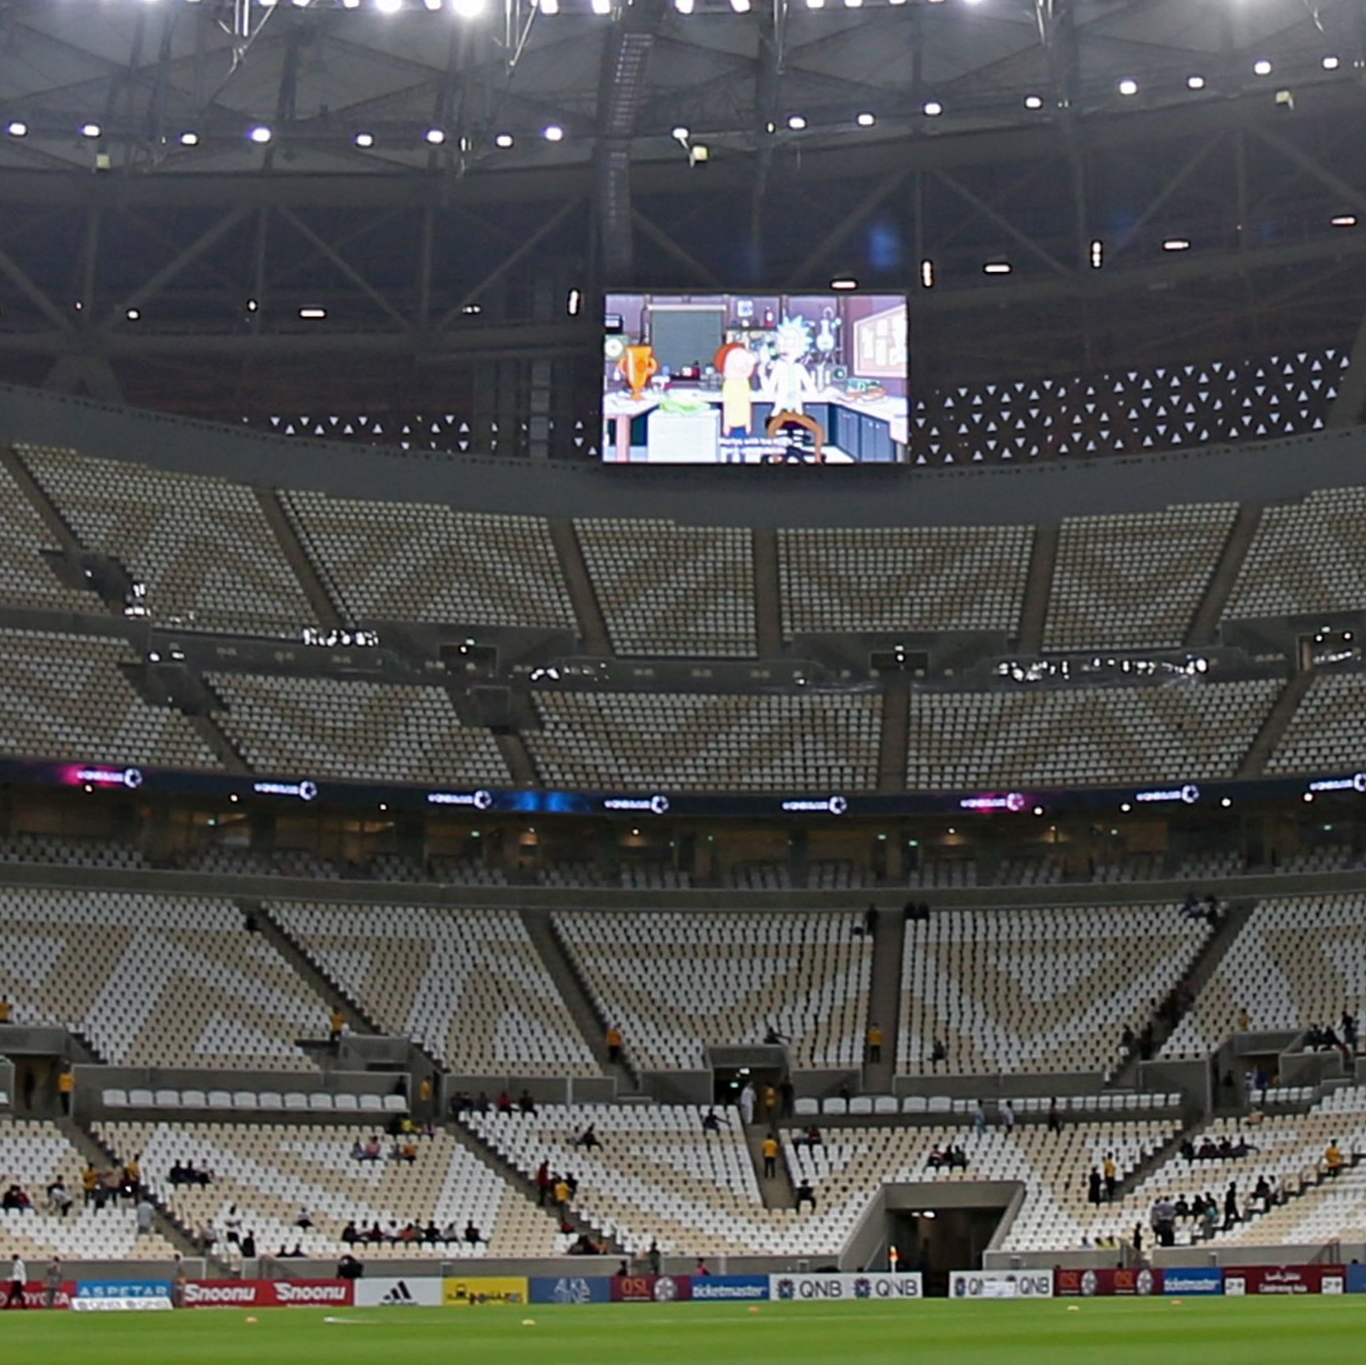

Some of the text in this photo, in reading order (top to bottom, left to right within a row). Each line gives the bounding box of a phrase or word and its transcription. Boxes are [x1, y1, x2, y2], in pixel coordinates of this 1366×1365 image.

[80, 1286, 167, 1297] ASPETAR
[186, 1284, 255, 1302] Snoonu
[274, 1283, 345, 1301] Snoonu
[800, 1280, 842, 1297] QNB
[875, 1279, 917, 1297] QNB
[1020, 1277, 1049, 1294] QNB
